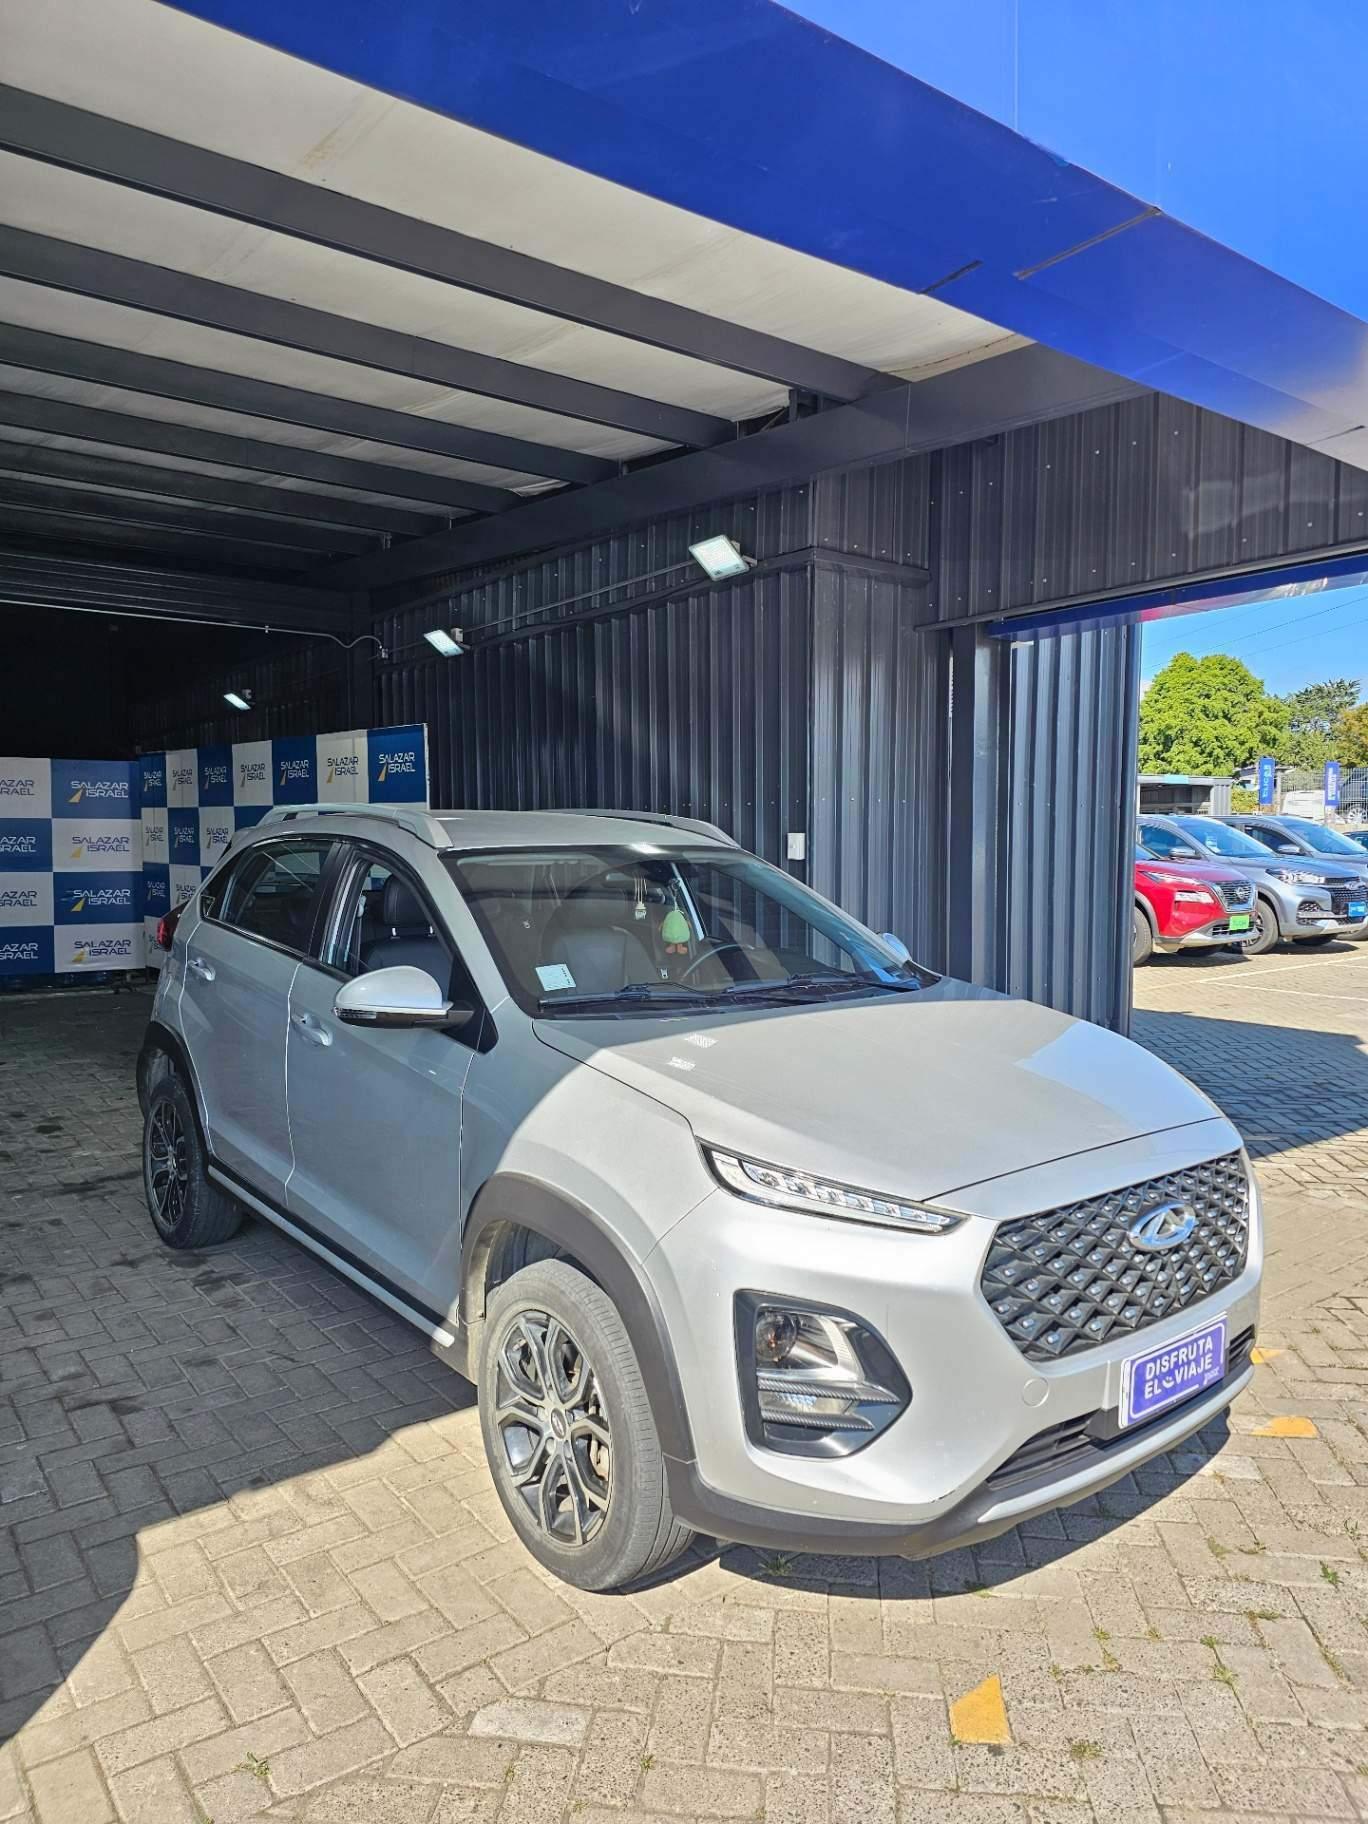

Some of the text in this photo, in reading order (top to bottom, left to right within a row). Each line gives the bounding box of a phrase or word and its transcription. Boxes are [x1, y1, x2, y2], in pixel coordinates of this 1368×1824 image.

[327, 756, 359, 767] SALAZAR
[378, 751, 415, 764] SALAZAR
[240, 763, 266, 773] SALAZAR
[280, 760, 309, 770] SALAZAR
[388, 762, 416, 773] ISRAEL
[288, 769, 310, 779] ISRAEL
[335, 766, 359, 776] ISRAEL
[0, 779, 35, 788] AZAR
[71, 781, 129, 790] SALAZAR
[0, 787, 36, 796] RAEL
[85, 789, 129, 798] ISRAEL
[0, 836, 36, 845] AZAR
[71, 836, 130, 845] SALAZAR
[0, 844, 37, 853] RAEL
[87, 844, 131, 853] ISRAEL
[0, 890, 38, 899] AZAR
[73, 889, 131, 898] SALAZAR
[0, 898, 38, 907] SRAEL
[88, 897, 132, 905] ISRAEL
[0, 942, 39, 952] AZAR
[74, 939, 132, 949] SALAZAR
[0, 950, 39, 960] SRAEL
[89, 948, 132, 956] ISRAEL
[1146, 1335, 1213, 1380] DISFRUTA
[1144, 1378, 1162, 1400] EL
[1174, 1353, 1213, 1384] VIAJE
